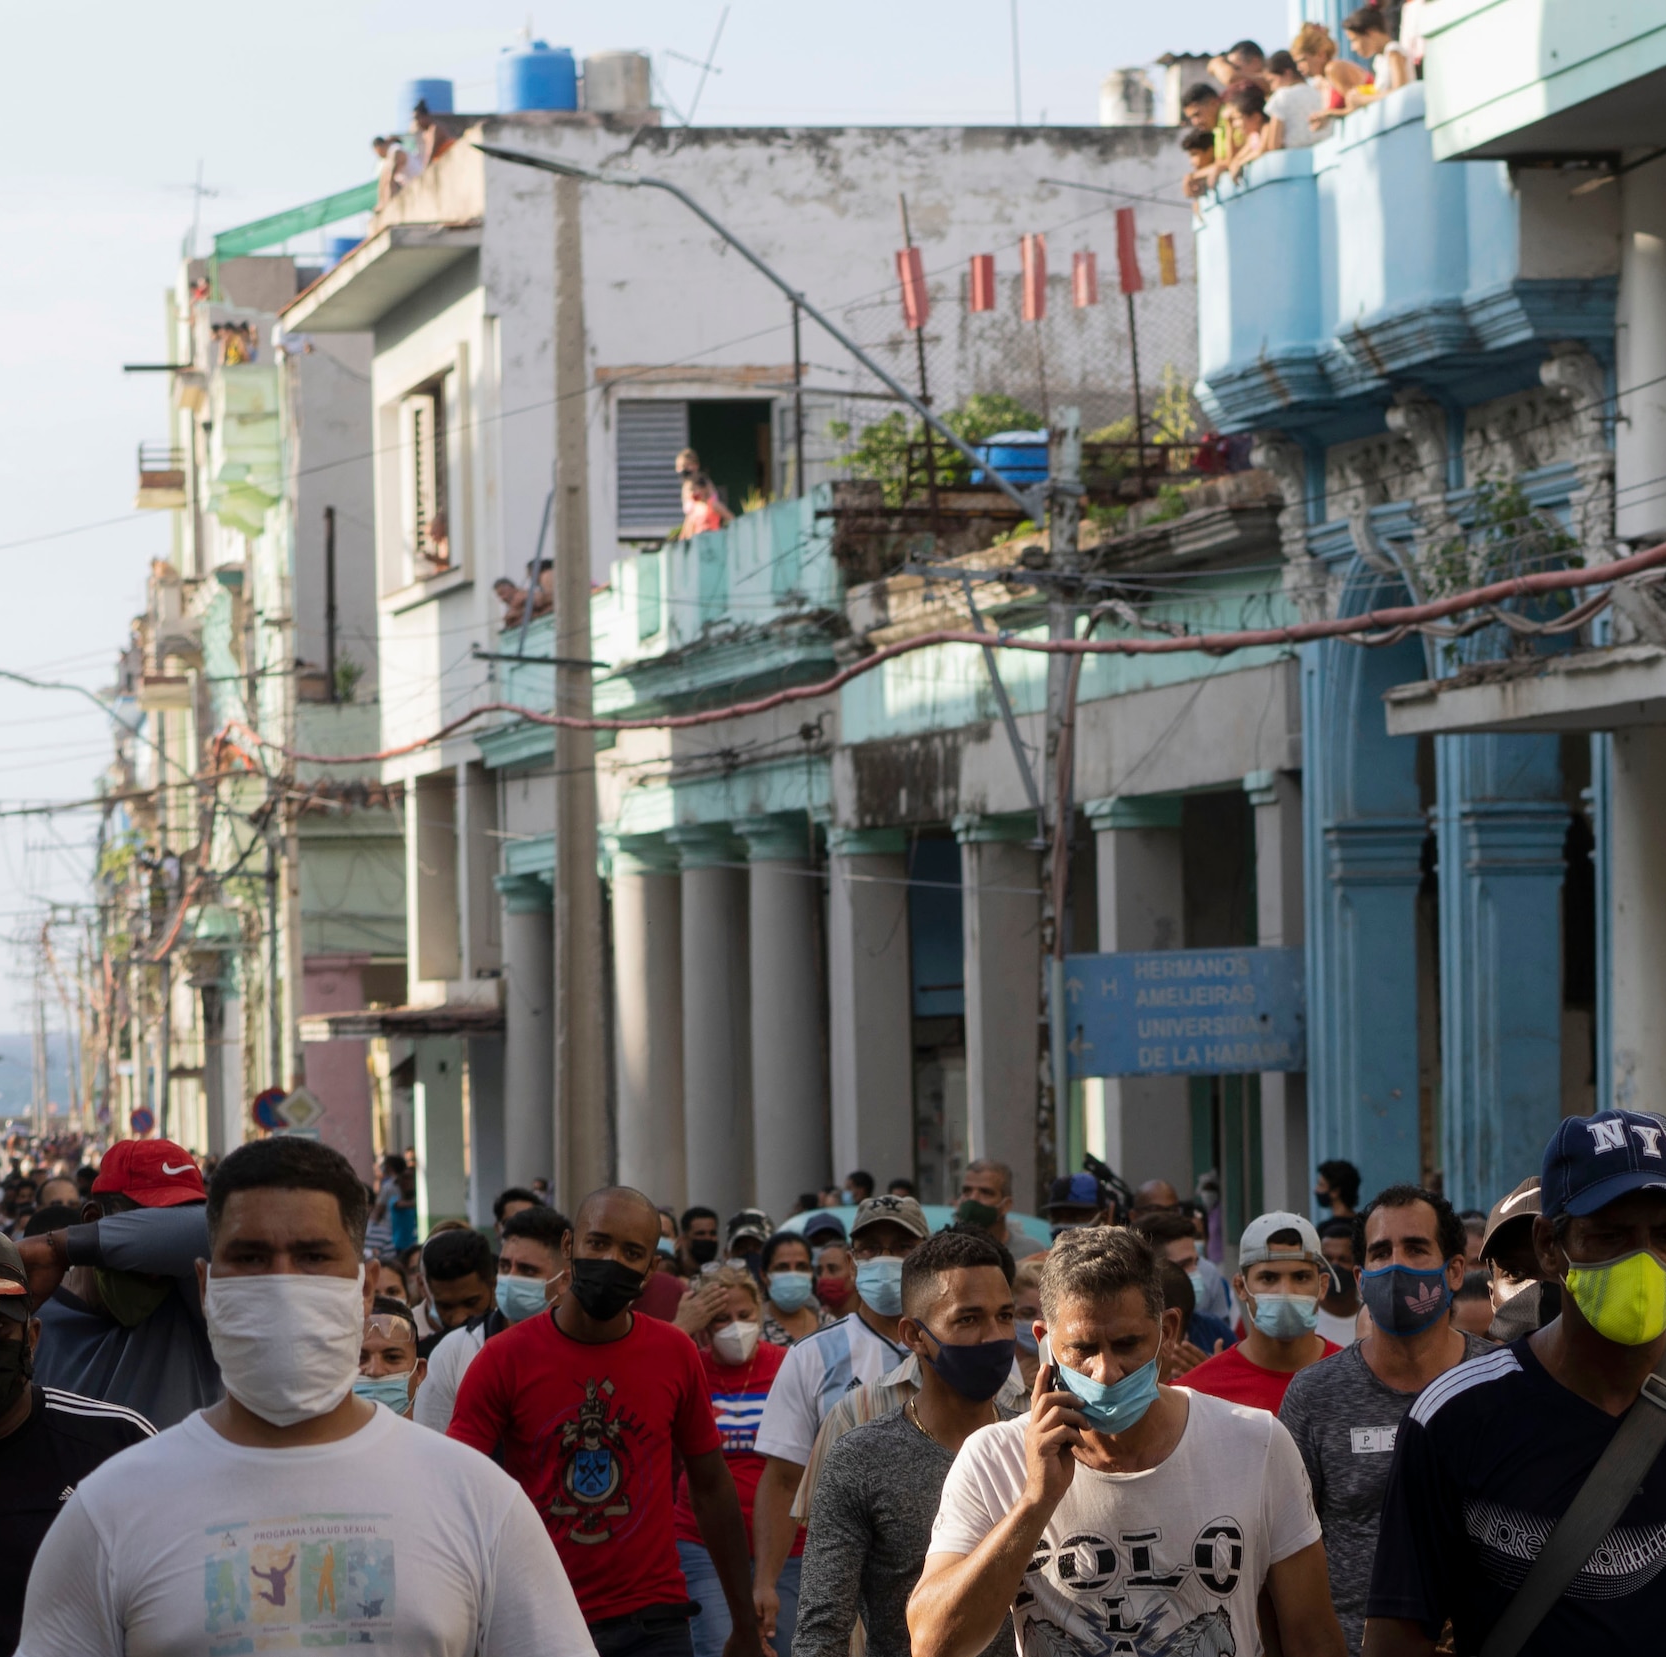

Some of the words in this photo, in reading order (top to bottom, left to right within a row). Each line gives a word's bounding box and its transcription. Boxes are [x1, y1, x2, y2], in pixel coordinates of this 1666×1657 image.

[1134, 956, 1250, 980] HERMANOS
[1139, 1047, 1167, 1068] DE
[1172, 1045, 1200, 1066] LA
[254, 1528, 306, 1541] PROGRAMA
[309, 1526, 340, 1535] SALUD
[343, 1526, 378, 1535] SEXUAL
